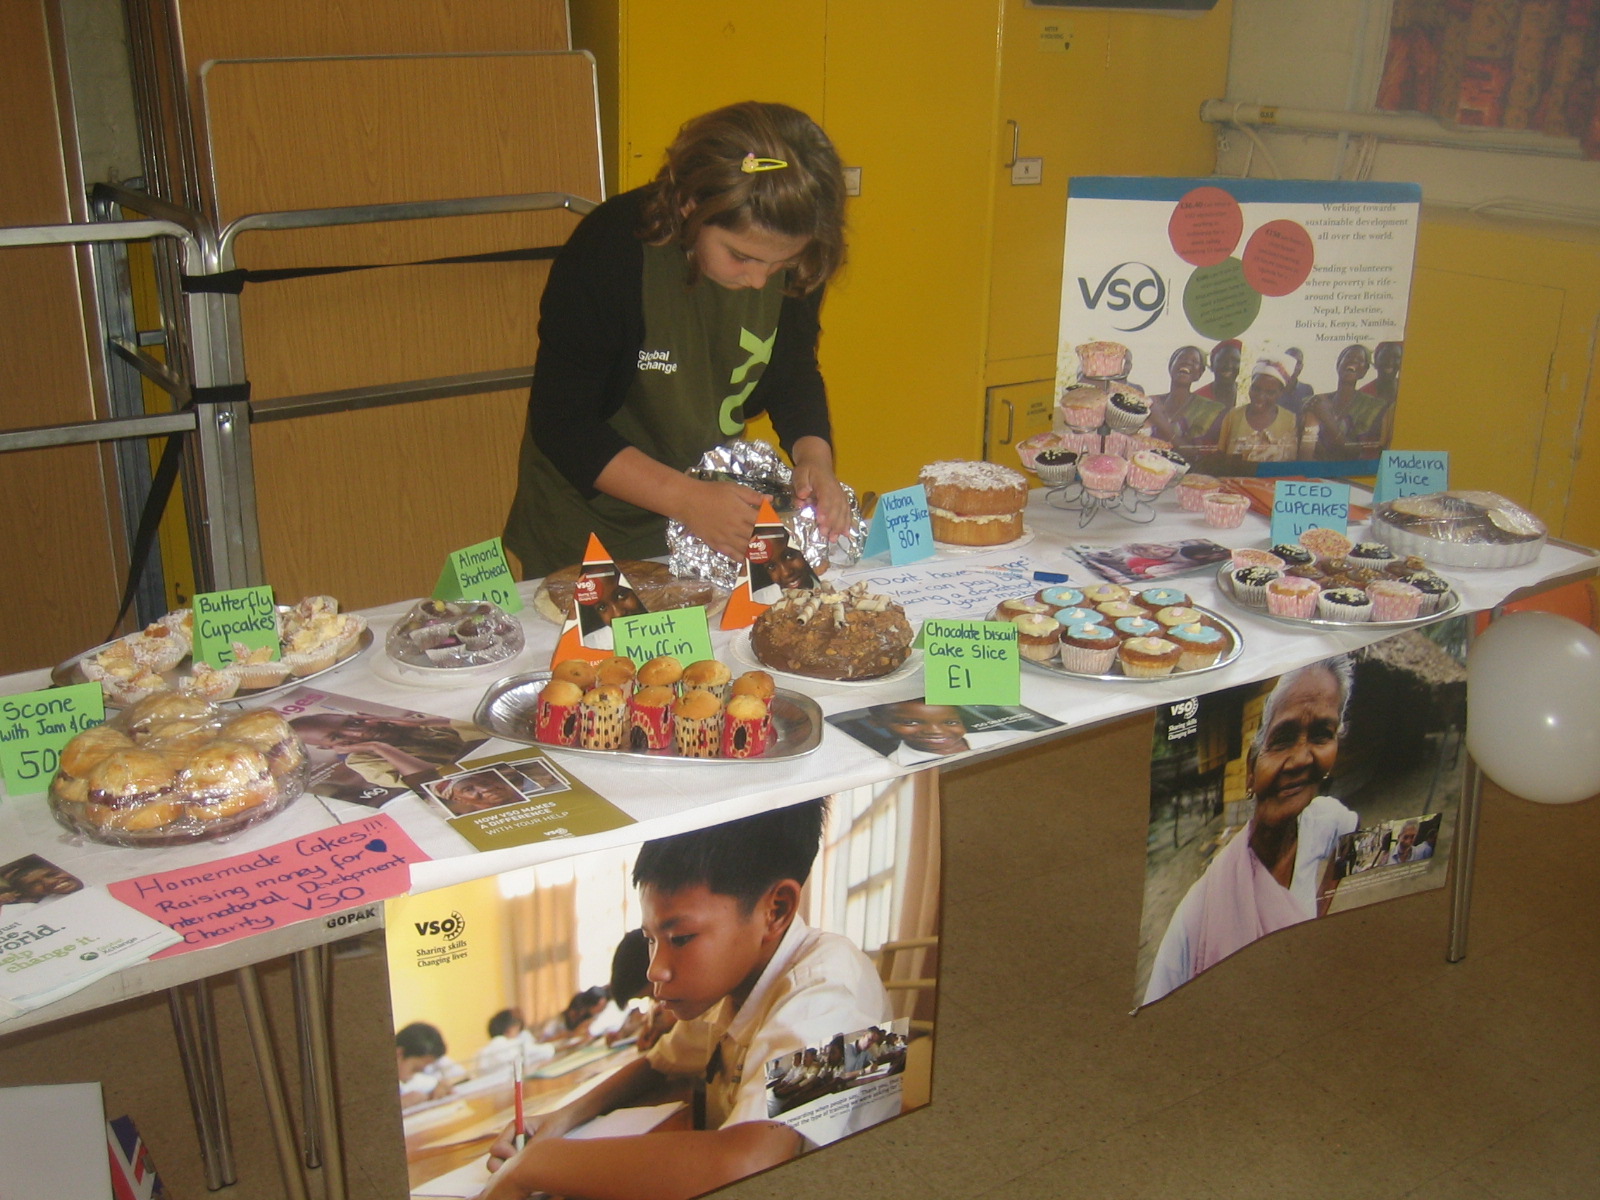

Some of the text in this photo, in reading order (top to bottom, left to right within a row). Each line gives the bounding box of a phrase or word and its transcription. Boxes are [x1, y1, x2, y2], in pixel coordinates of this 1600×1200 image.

[1322, 204, 1396, 214] Working towards
[1305, 218, 1408, 228] sustainable development
[1318, 232, 1329, 240] all
[1352, 232, 1366, 240] the
[1368, 232, 1393, 240] world.
[1312, 264, 1392, 274] Sending volunteers
[1332, 280, 1365, 288] poverty
[1376, 278, 1388, 286] rife
[1078, 268, 1166, 318] VSO
[1304, 292, 1394, 301] around Great Britain,
[1313, 306, 1383, 316] Nepal, Palestine,
[1295, 319, 1397, 330] Bolivia, Kenya, Namibia,
[638, 350, 670, 361] Global
[1388, 455, 1444, 471] Madeira
[1394, 472, 1430, 486] Slice
[1284, 484, 1332, 498] ICED
[1274, 500, 1348, 519] CUPCAKES
[886, 508, 929, 532] Sponge Slice
[898, 530, 920, 549] 80p
[459, 540, 499, 569] Almond
[460, 556, 508, 588] Shortbread
[867, 572, 923, 586] Don't
[925, 583, 956, 591] can
[199, 591, 274, 616] Butterfly
[201, 614, 275, 644] Cupcakes
[624, 614, 676, 639] Fruit
[926, 622, 1018, 641] Chocolate biscuit
[626, 638, 693, 662] Muffin
[930, 642, 1008, 660] Cake Slice
[3, 698, 76, 721] Scone
[1171, 701, 1194, 716] VSO
[0, 722, 30, 742] with
[36, 718, 66, 736] Jam
[474, 802, 556, 825] HOW VSO MAKES
[488, 809, 552, 826] DIFFERENCE
[486, 811, 569, 836] WITH YOUR HELP
[135, 821, 388, 898] Homemade Cakes!!!
[155, 850, 364, 913] Raising money for
[166, 854, 406, 931] nternational Development
[182, 886, 366, 945] Charity VSO
[326, 908, 376, 928] GOPAK
[414, 918, 456, 936] VSO
[416, 940, 468, 956] Sharing skills
[6, 944, 76, 974] change
[417, 952, 468, 968] Changing lives
